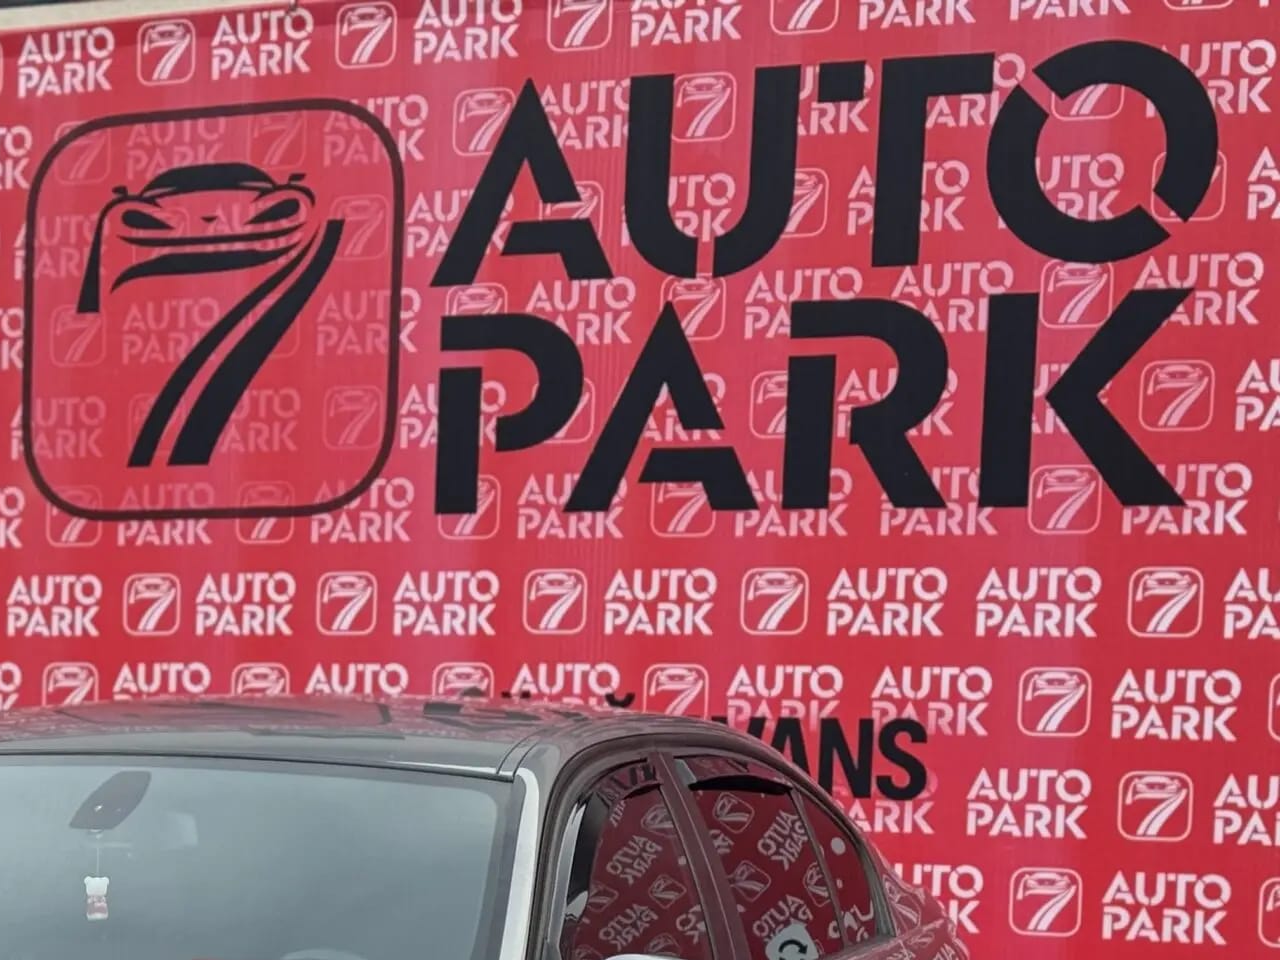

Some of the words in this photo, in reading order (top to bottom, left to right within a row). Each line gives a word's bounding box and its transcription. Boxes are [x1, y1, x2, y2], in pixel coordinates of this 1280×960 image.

[210, 6, 314, 47] AUTO
[413, 0, 522, 31] AUTO
[628, 6, 743, 48] PARK
[858, 0, 976, 31] PARK
[16, 26, 114, 66] AUTO
[211, 39, 311, 80] PARK
[413, 24, 519, 65] PARK
[18, 58, 112, 99] PARK
[430, 39, 1219, 287] AUTO
[744, 266, 863, 304] AUTO
[887, 260, 1019, 299] AUTO
[1133, 252, 1264, 291] AUTO
[525, 276, 637, 312] AUTO
[435, 287, 1196, 515] PARK
[117, 517, 213, 547] PARK
[310, 508, 412, 544] PARK
[516, 507, 624, 540] PARK
[734, 504, 848, 538] PARK
[880, 502, 999, 537] PARK
[1121, 499, 1247, 536] PARK
[7, 574, 102, 605] AUTO
[196, 571, 296, 604] AUTO
[393, 570, 499, 604] AUTO
[604, 568, 717, 601] AUTO
[827, 567, 948, 601] AUTO
[976, 566, 1102, 602] AUTO
[7, 605, 99, 637] PARK
[196, 604, 292, 636] PARK
[393, 602, 496, 636] PARK
[604, 601, 714, 635] PARK
[827, 602, 944, 636] PARK
[976, 602, 1097, 637] PARK
[113, 661, 211, 695] AUTO
[305, 660, 409, 695] AUTO
[510, 661, 621, 697] AUTO
[725, 663, 844, 699] AUTO
[871, 665, 993, 700] AUTO
[1112, 669, 1241, 705] AUTO
[871, 701, 990, 737] PARK
[1111, 704, 1237, 741] PARK
[967, 768, 1091, 803] AUTO
[967, 802, 1087, 839] PARK
[1102, 871, 1231, 909] AUTO
[1102, 906, 1226, 945] PARK
